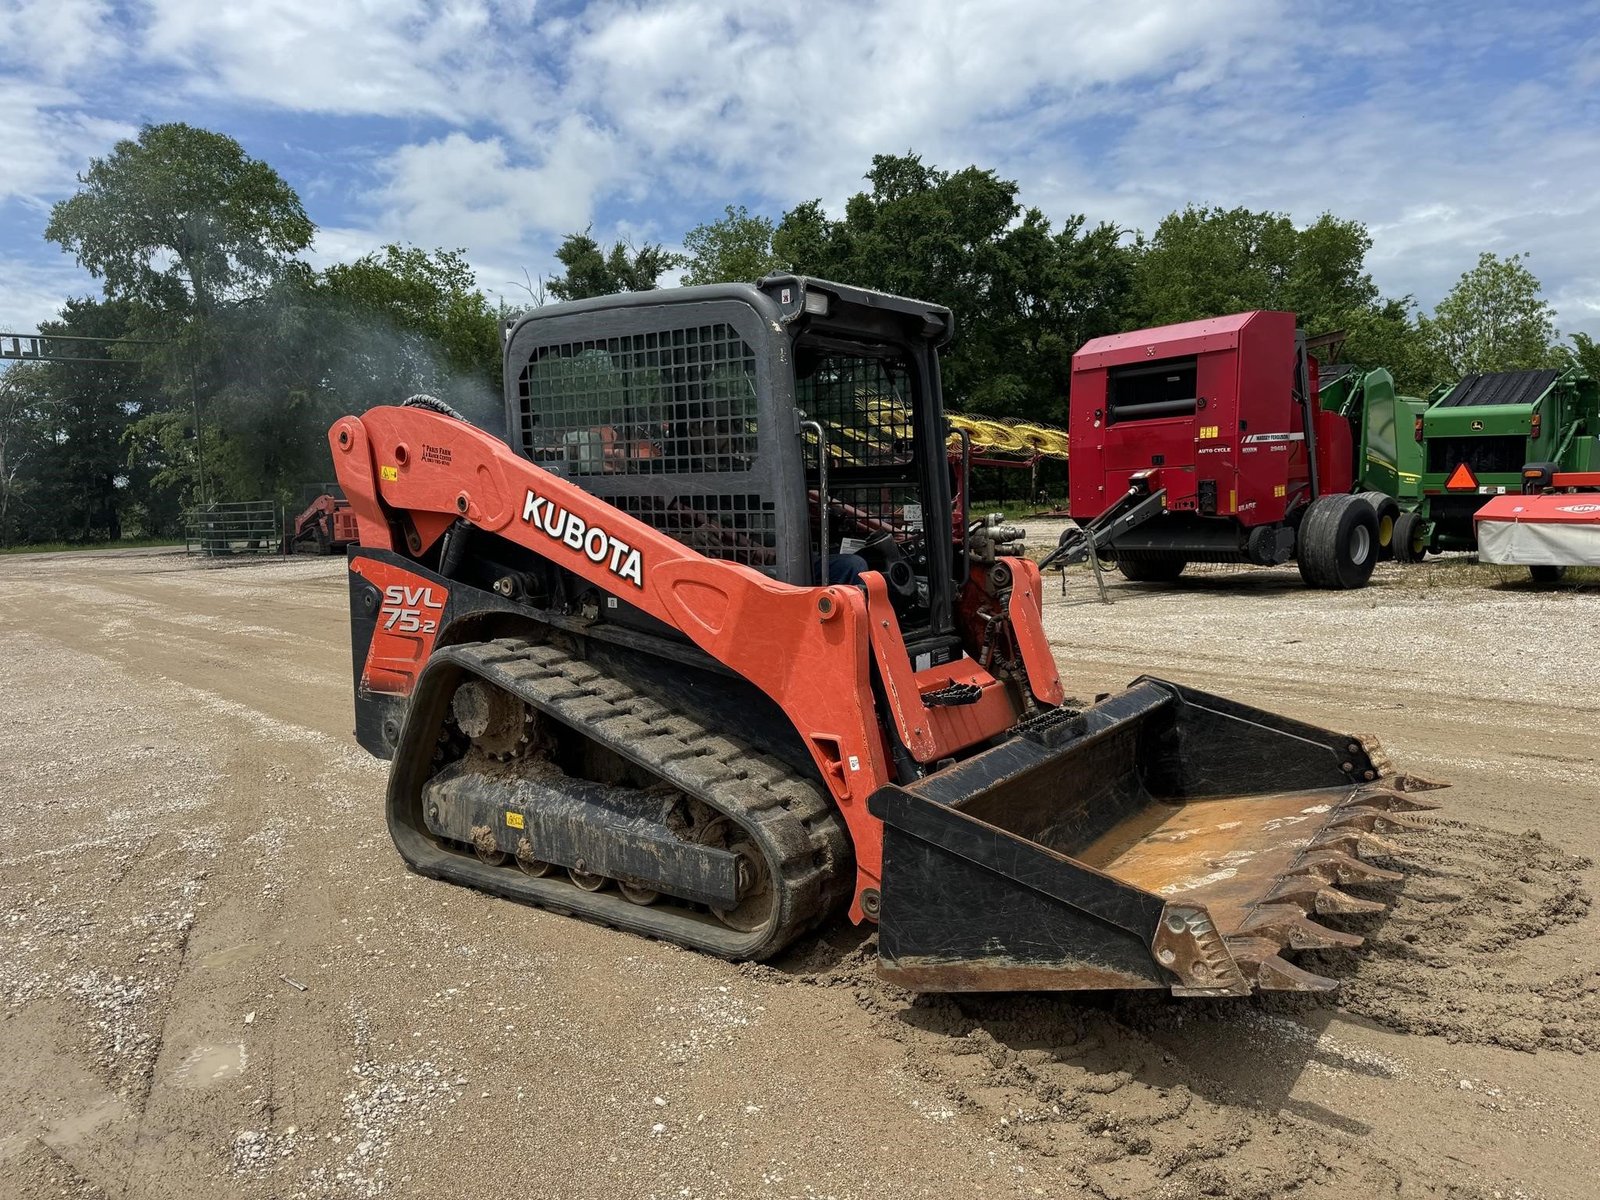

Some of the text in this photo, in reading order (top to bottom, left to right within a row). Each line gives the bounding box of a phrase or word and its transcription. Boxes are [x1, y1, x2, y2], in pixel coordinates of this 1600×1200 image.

[521, 489, 643, 588] KUBOTA
[383, 585, 442, 608] SVL
[382, 607, 436, 634] 75-2
